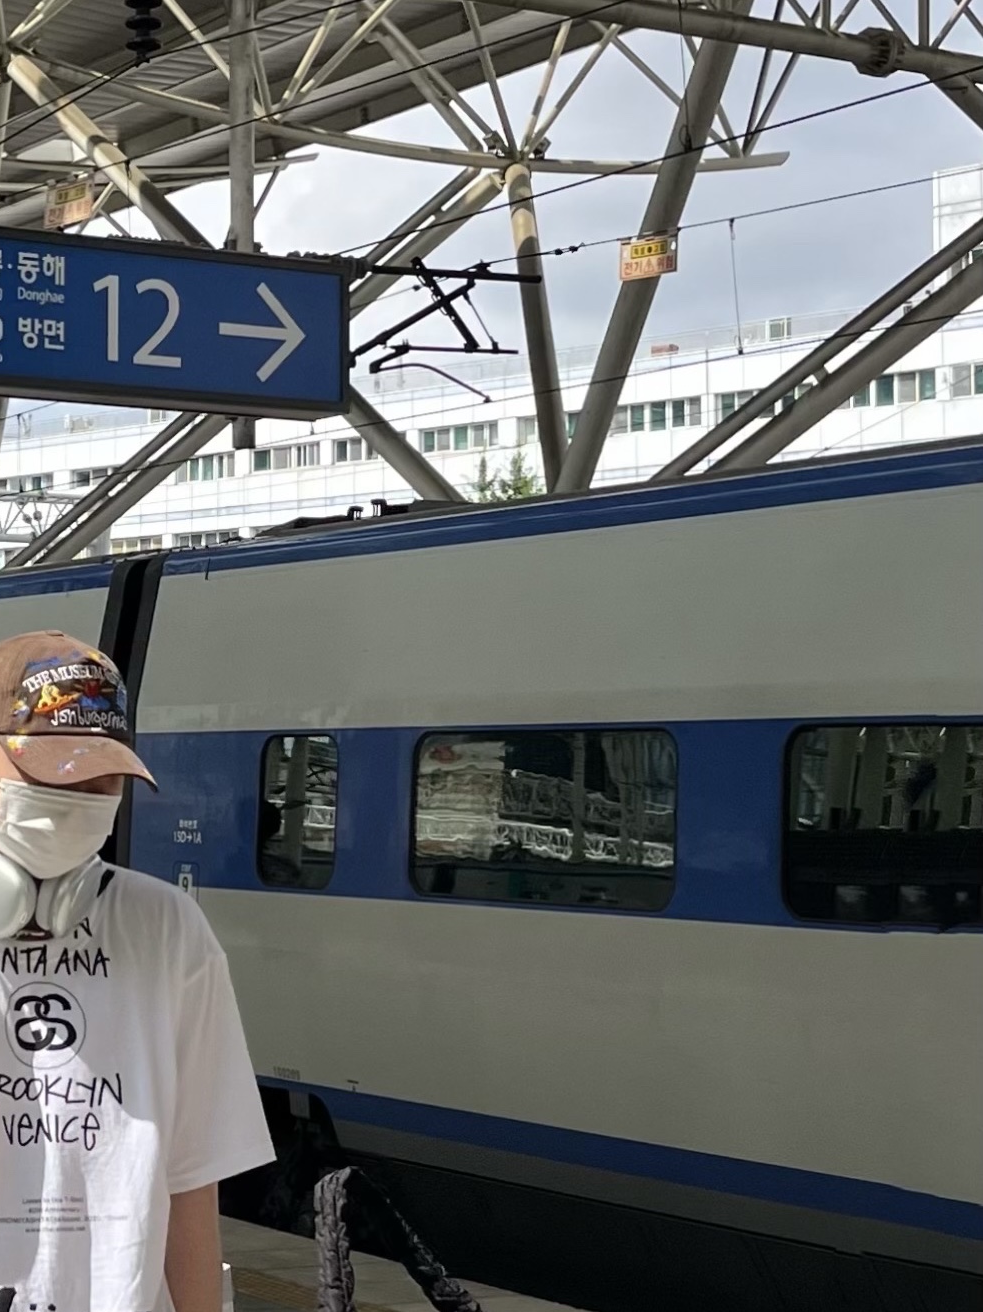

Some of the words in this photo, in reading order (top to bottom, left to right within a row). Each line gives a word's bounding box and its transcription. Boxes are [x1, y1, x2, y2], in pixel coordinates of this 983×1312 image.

[17, 251, 66, 287] 동해
[17, 286, 65, 305] Donghae
[17, 317, 65, 351] 방면
[92, 274, 182, 368] 12
[22, 669, 52, 694] THE
[54, 947, 110, 978] ANA
